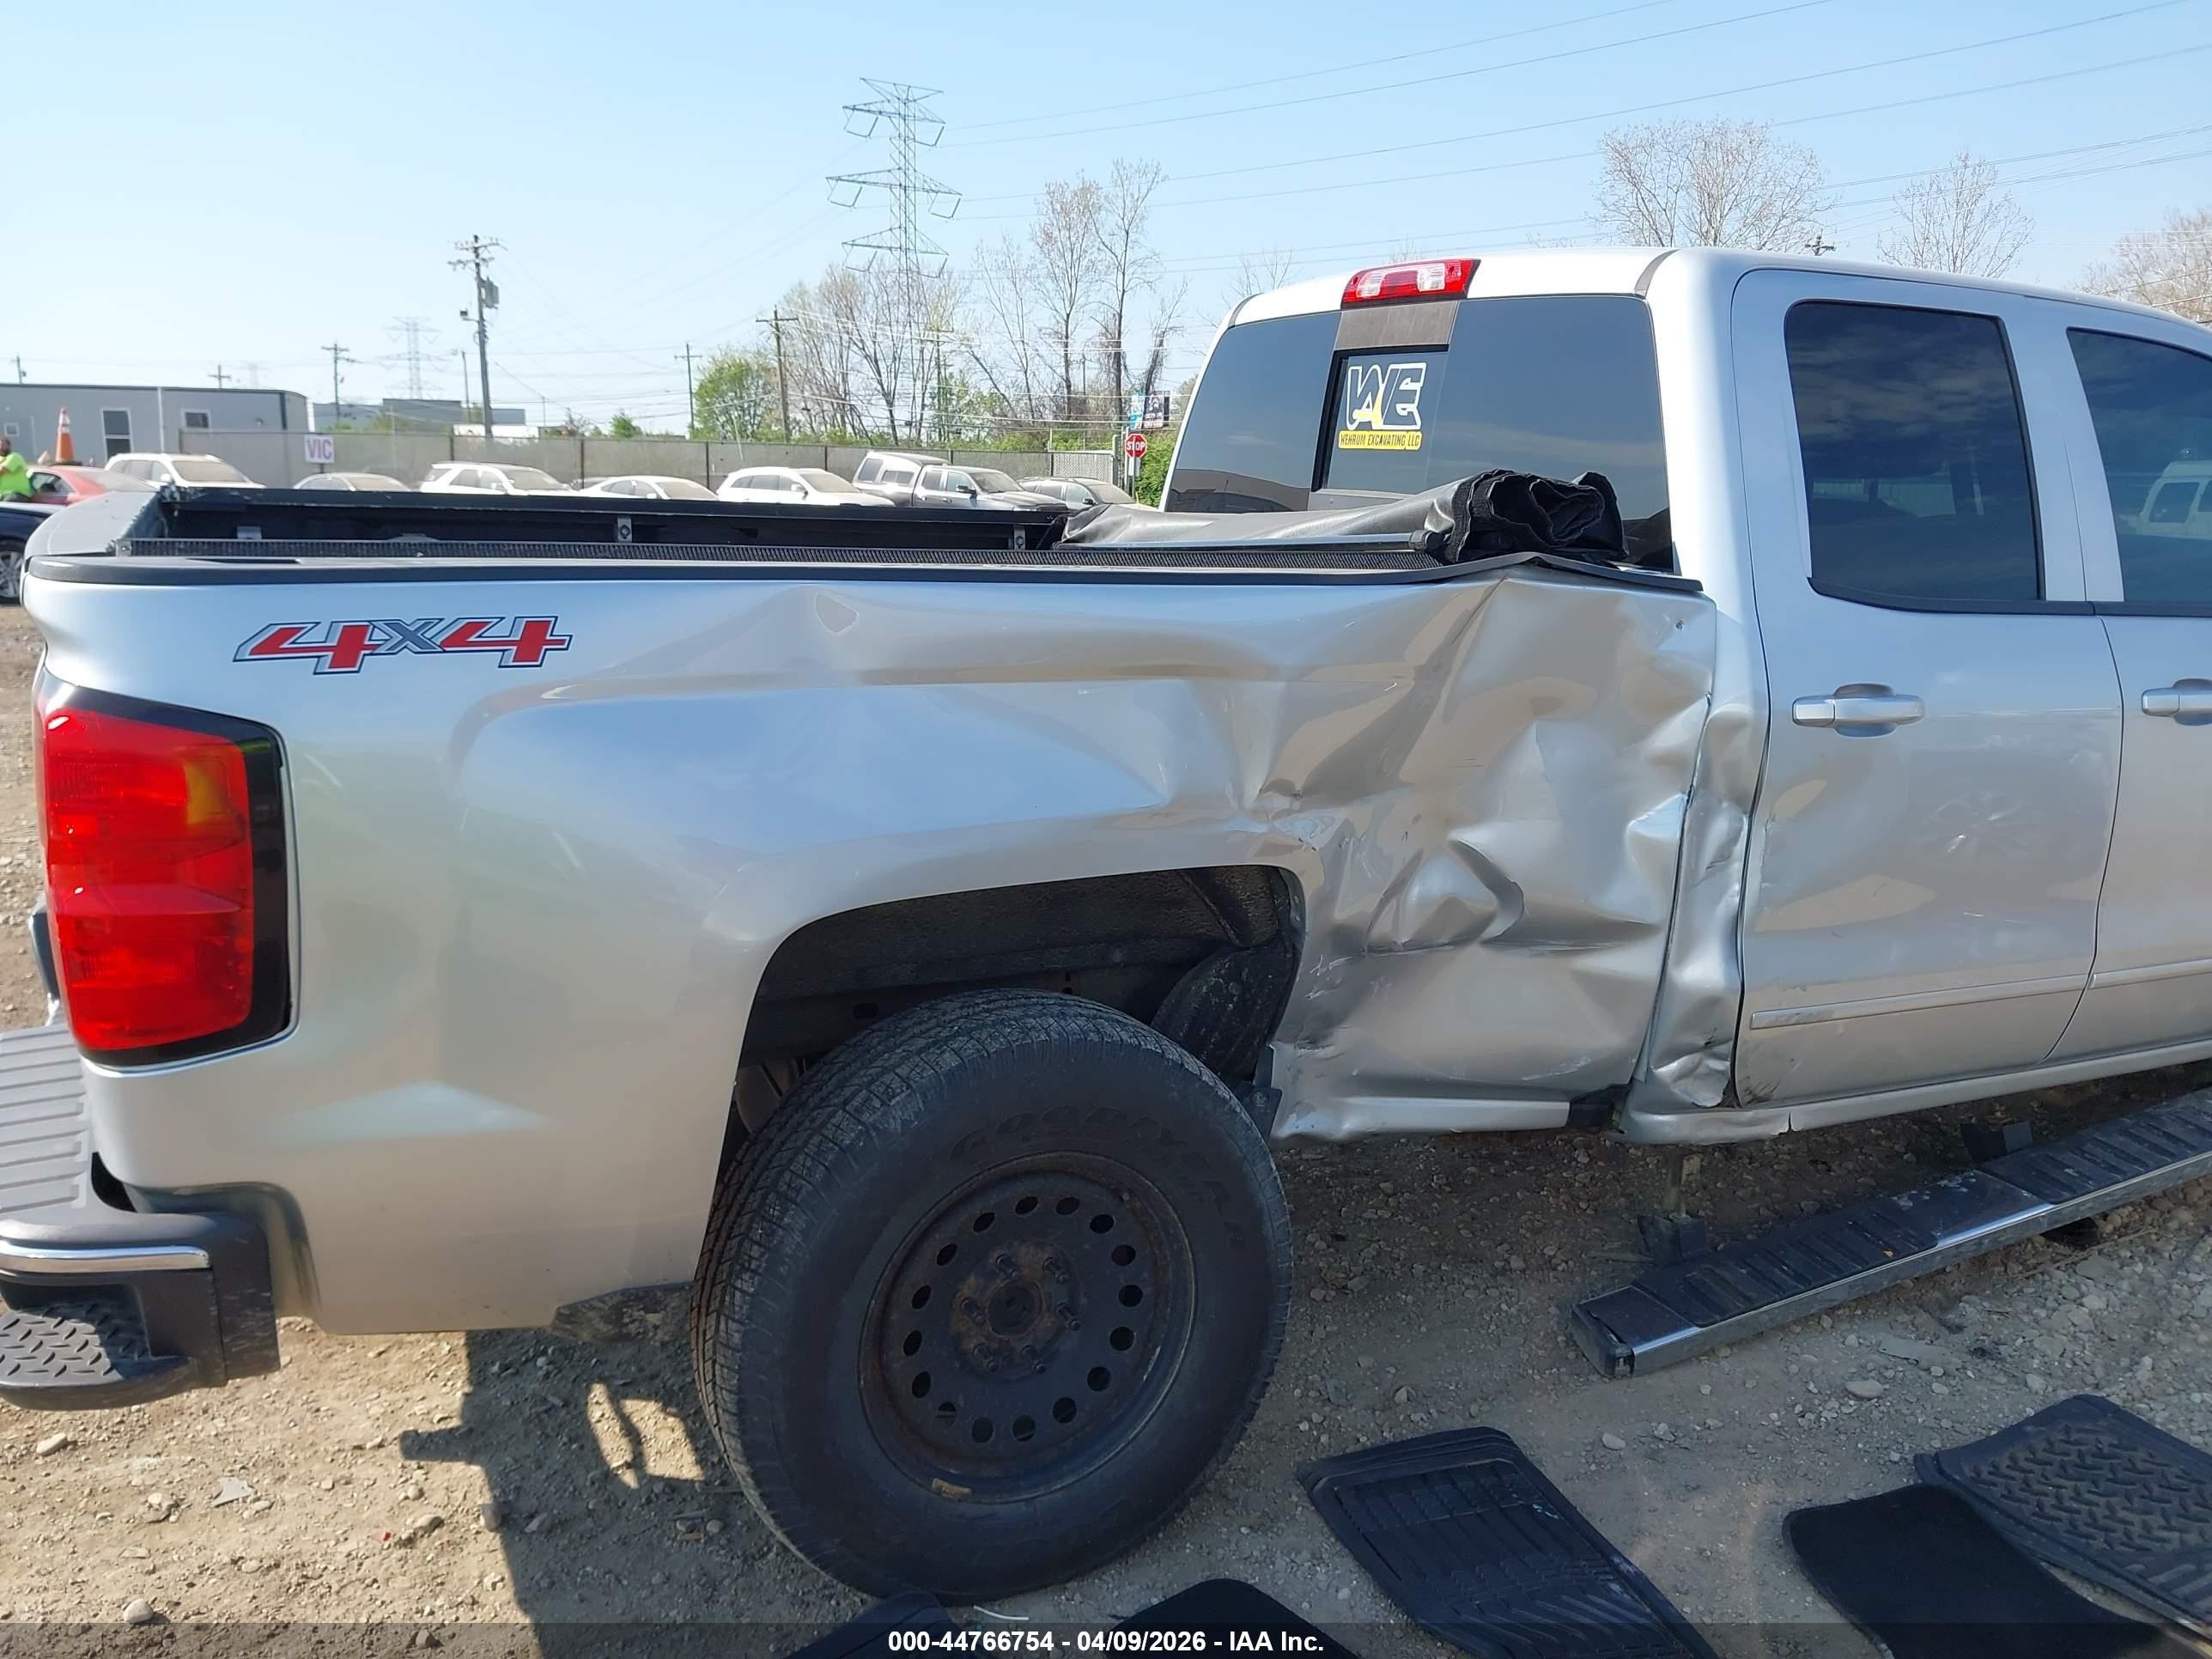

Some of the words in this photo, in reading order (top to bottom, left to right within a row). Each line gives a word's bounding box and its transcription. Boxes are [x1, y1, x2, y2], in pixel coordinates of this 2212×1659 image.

[1126, 441, 1146, 451] STOP
[1340, 434, 1366, 446] WEHRUM
[1368, 434, 1406, 447] EXCAVATING
[1408, 434, 1420, 447] LLC
[307, 439, 332, 459] VIC
